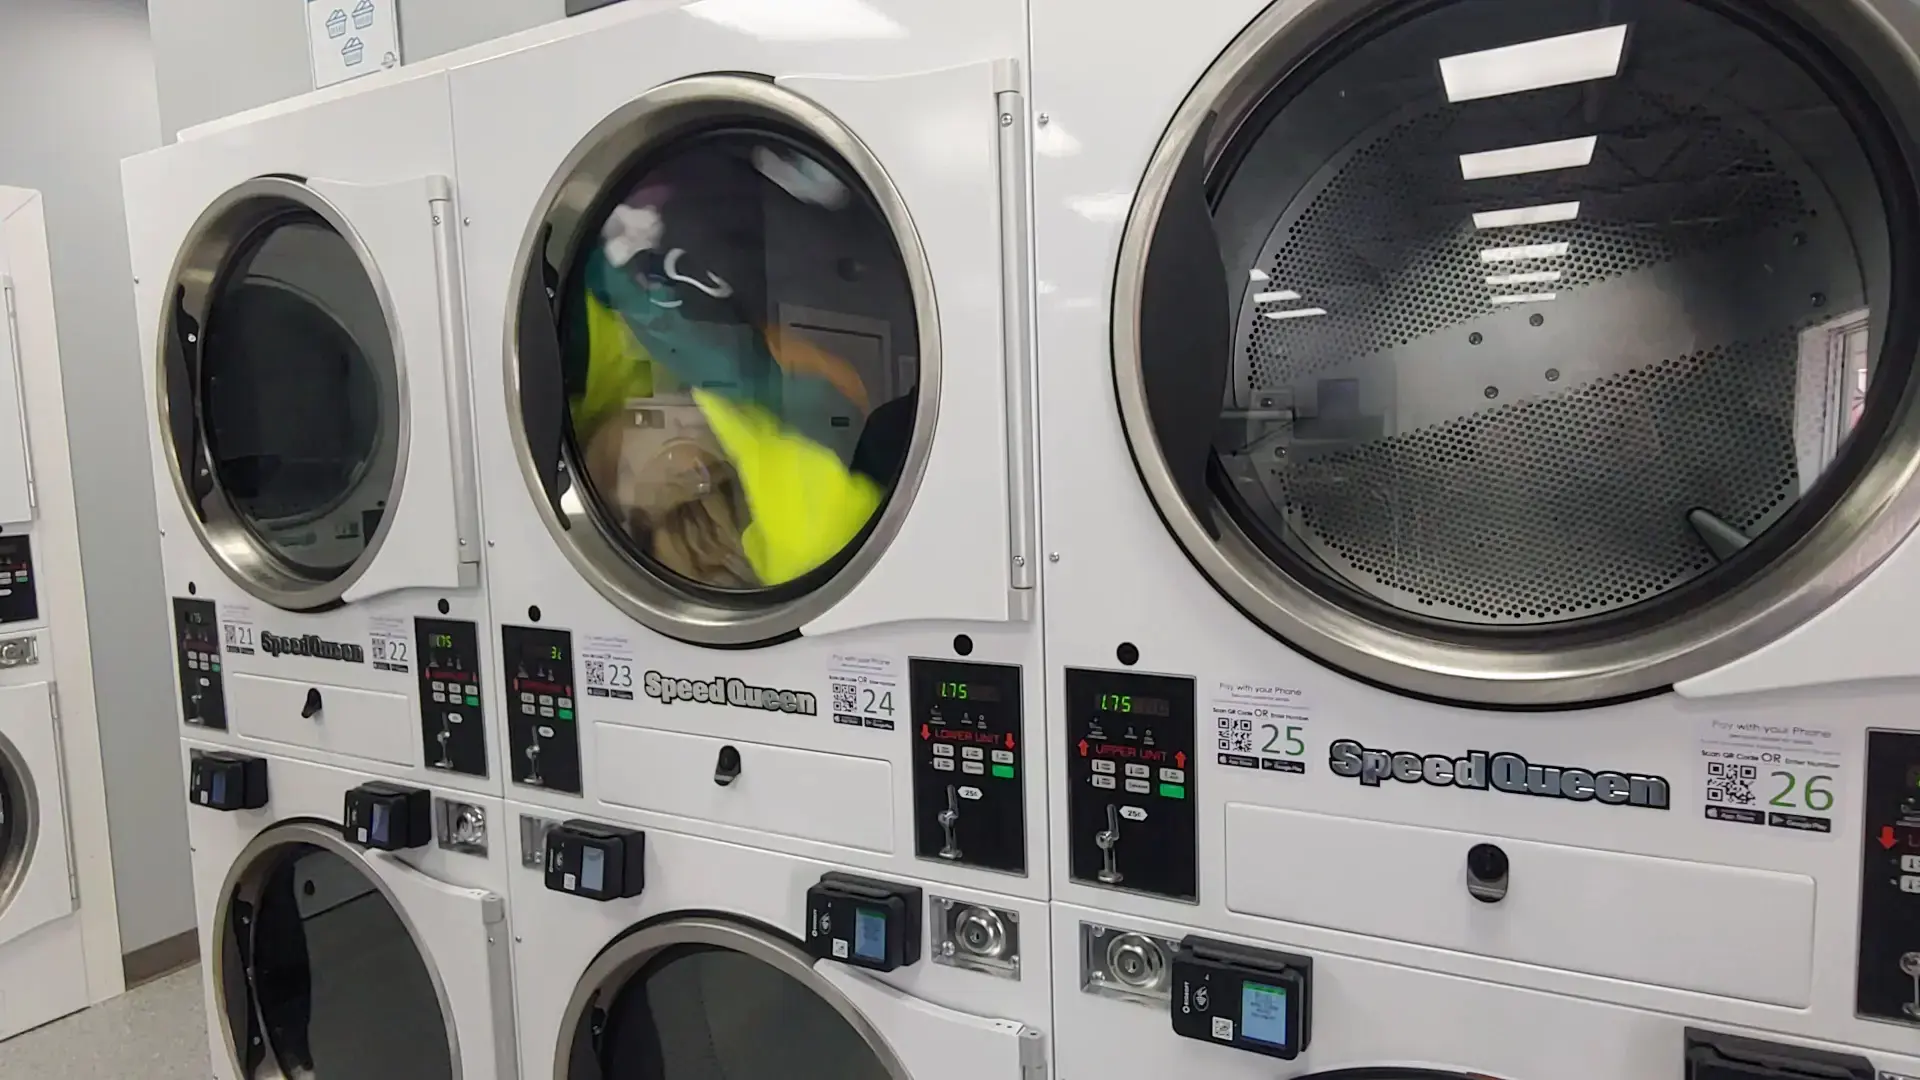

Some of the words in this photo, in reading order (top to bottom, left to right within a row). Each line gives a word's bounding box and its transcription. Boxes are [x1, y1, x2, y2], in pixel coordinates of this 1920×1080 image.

[237, 627, 253, 645] 21
[389, 641, 408, 662] 22
[608, 663, 633, 688] 23
[1237, 684, 1253, 692] with
[1255, 686, 1273, 694] your
[1274, 686, 1302, 696] Phone
[863, 688, 895, 716] 24
[1254, 708, 1268, 718] OR
[935, 729, 973, 740] LOWER
[975, 732, 1000, 744] UNIT
[1712, 719, 1733, 731] Pay
[1737, 723, 1760, 732] with
[1763, 725, 1789, 735] your
[1792, 726, 1832, 738] Phone
[1261, 723, 1305, 756] 25
[1095, 743, 1136, 757] UPPER
[1139, 748, 1167, 761] UNIT
[1701, 749, 1721, 758] Scan
[1736, 753, 1759, 761] Code
[1761, 752, 1781, 763] OR
[1768, 771, 1834, 811] 26
